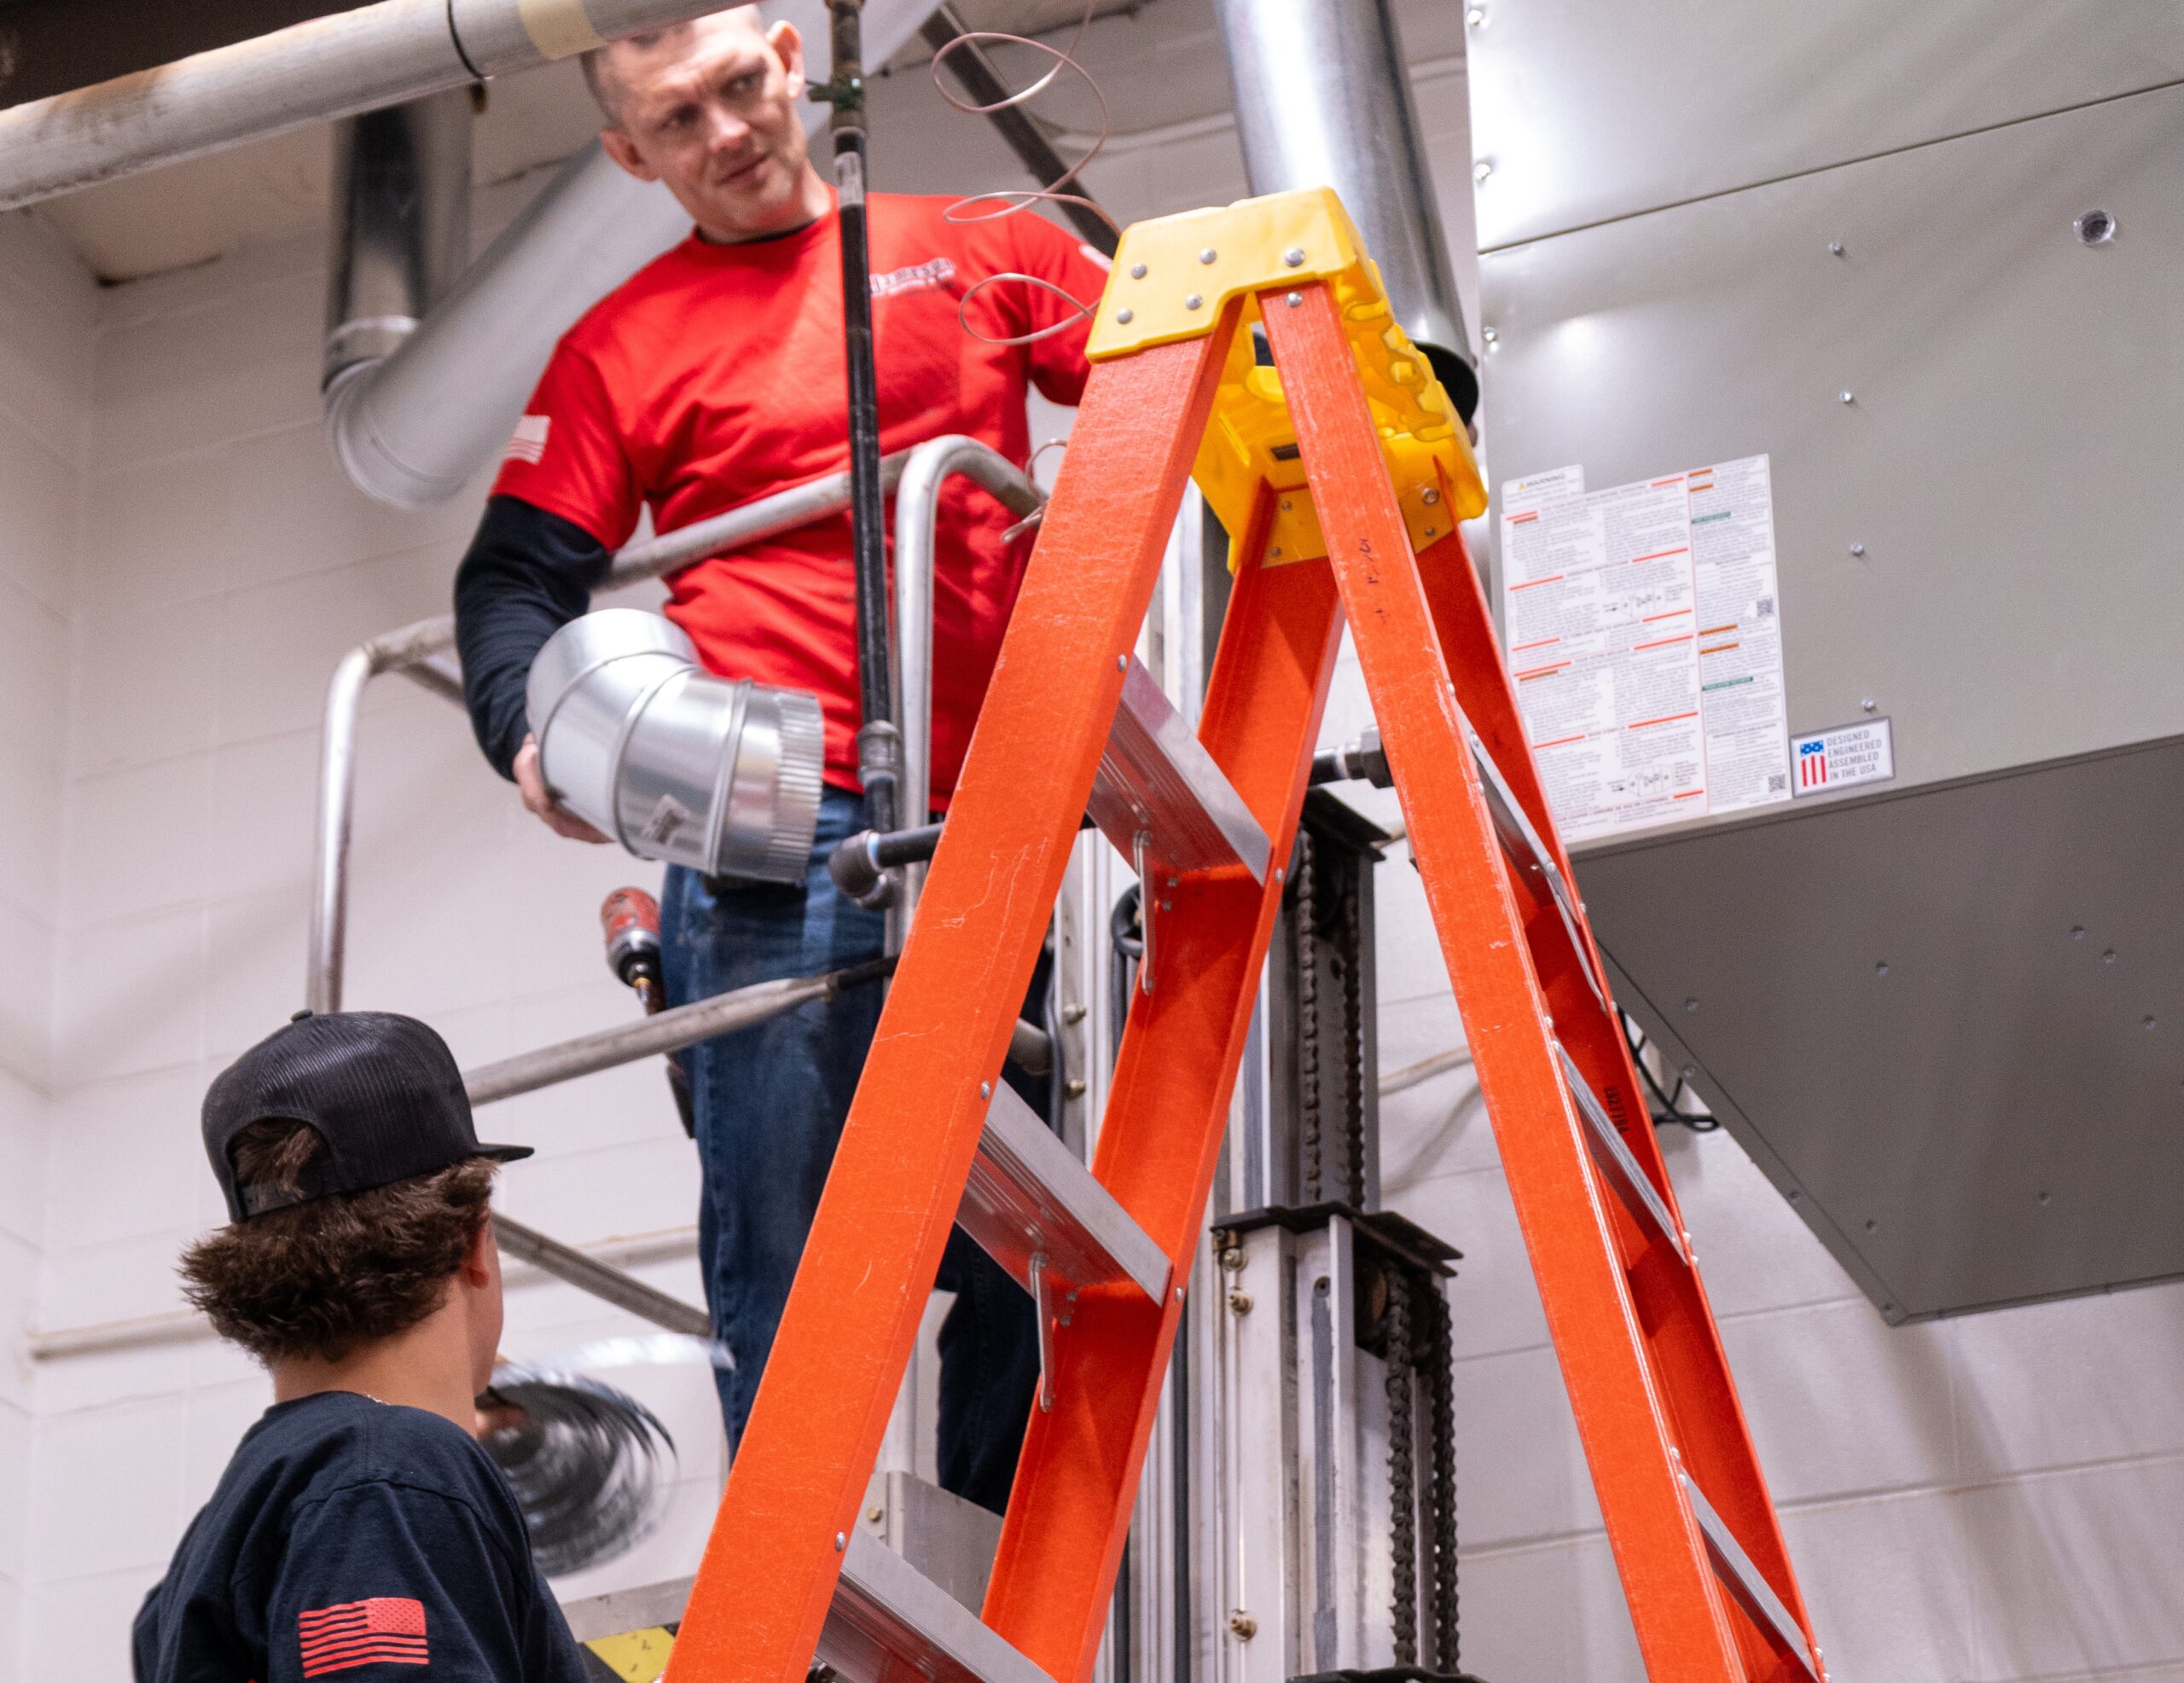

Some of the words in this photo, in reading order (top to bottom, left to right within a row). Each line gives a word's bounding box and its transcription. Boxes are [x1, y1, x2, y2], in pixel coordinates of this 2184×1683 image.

[1827, 730, 1869, 746] DESIGNED
[1827, 739, 1882, 758] ENGINEERED
[1828, 751, 1879, 769] ASSEMBLED
[1829, 770, 1838, 781] IN
[1842, 768, 1856, 778] THE
[1860, 763, 1877, 775] USA
